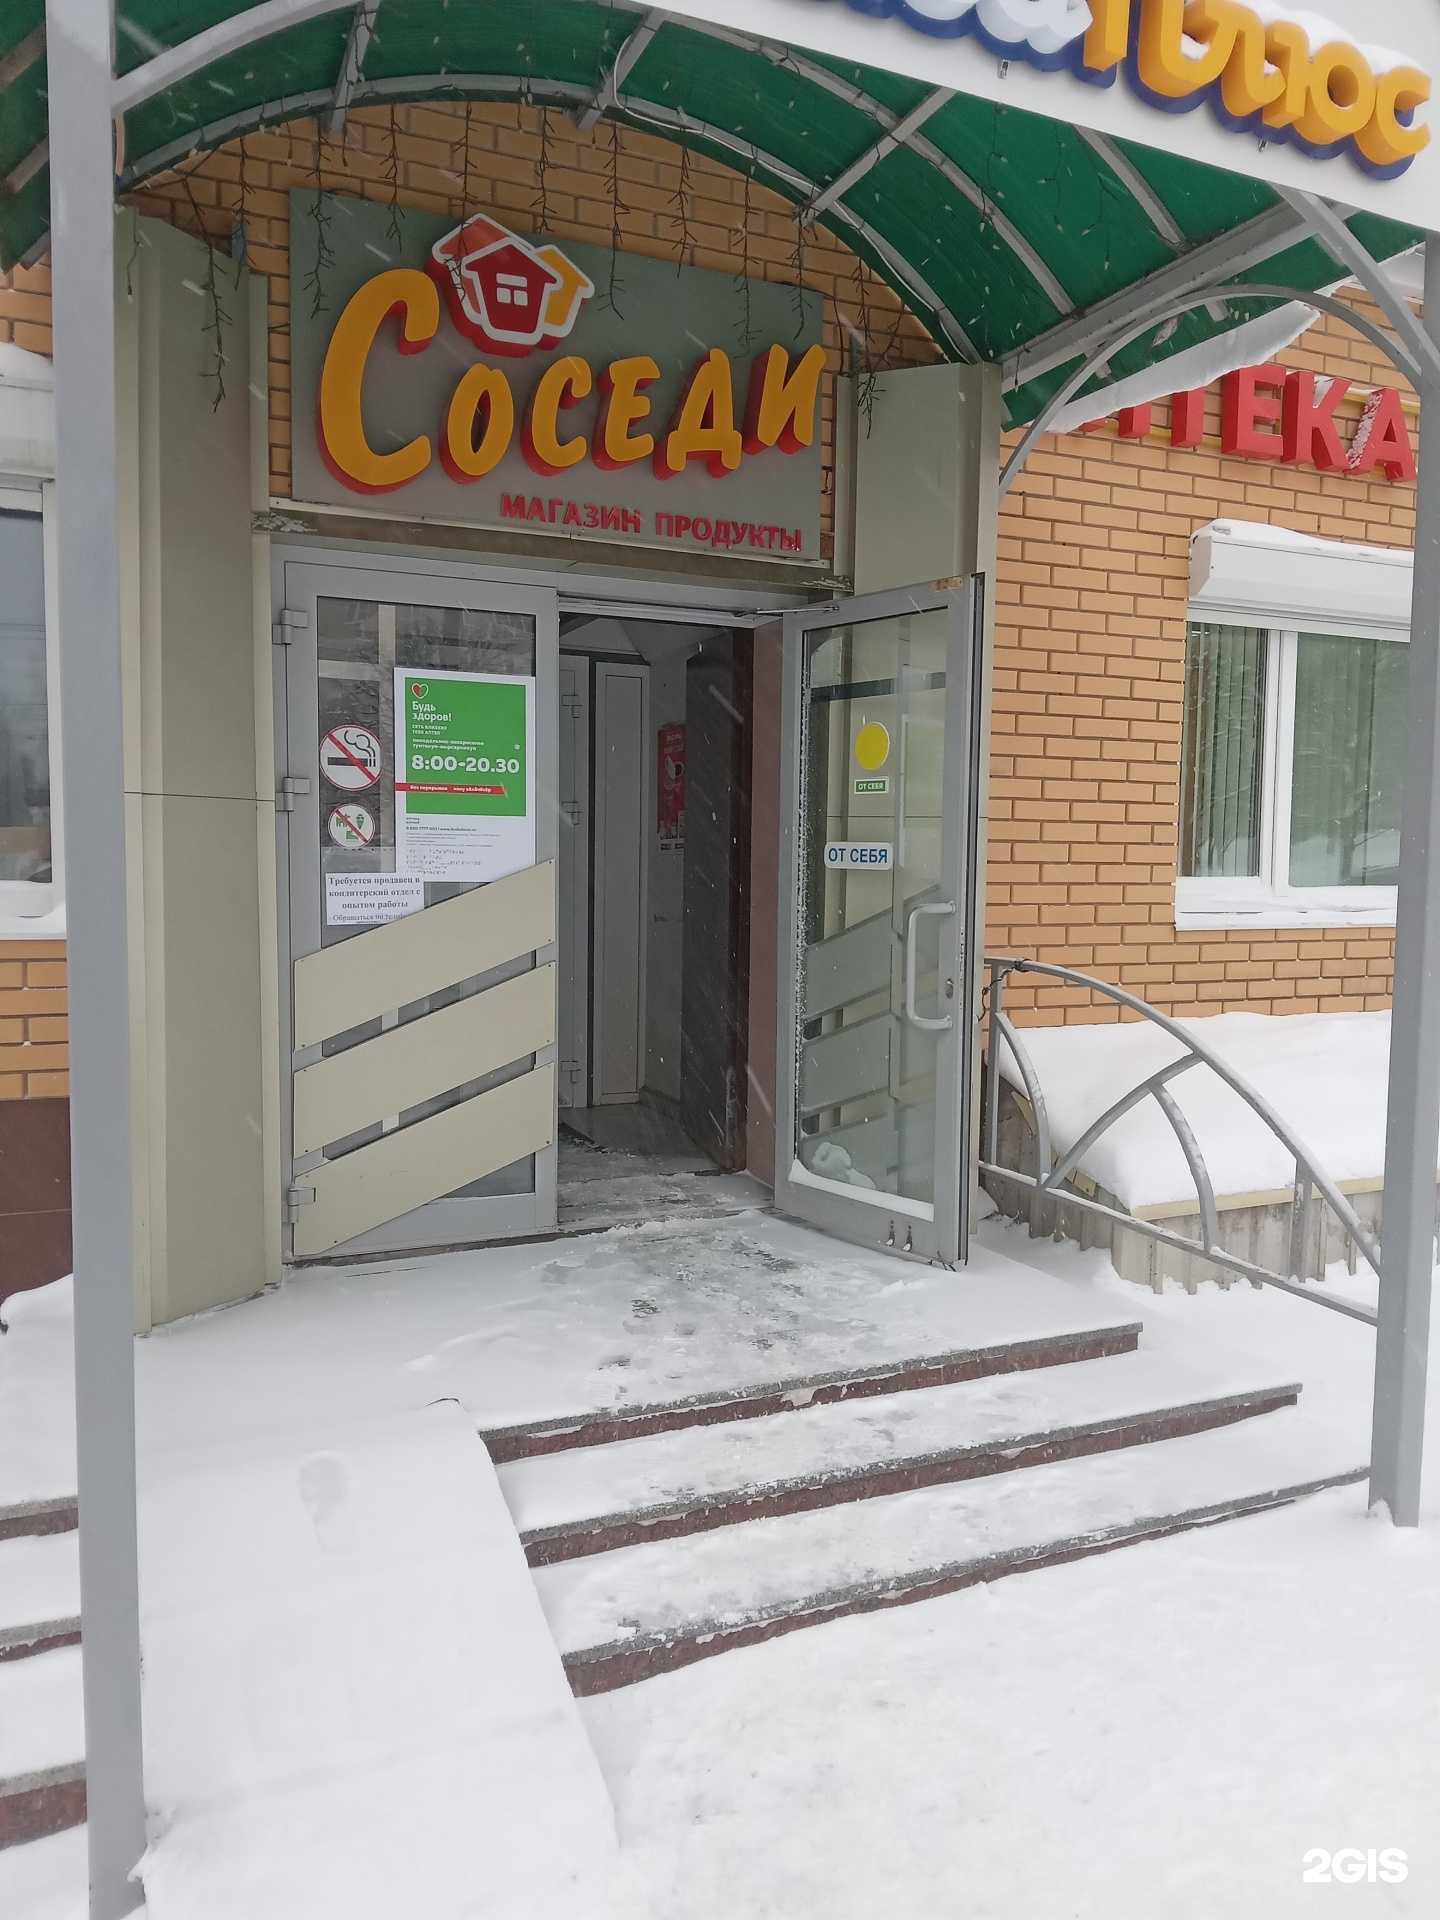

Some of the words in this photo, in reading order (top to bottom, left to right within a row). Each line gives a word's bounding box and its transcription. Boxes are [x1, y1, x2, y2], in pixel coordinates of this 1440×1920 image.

[500, 493, 642, 533] МАГАЗИН
[654, 512, 803, 551] ПРОДУКТЫ
[412, 701, 436, 712] Будь
[412, 712, 452, 722] здоров!
[411, 754, 520, 774] 8:00-20.30
[868, 782, 884, 790] СЕБЯ
[828, 847, 846, 862] ОТ
[850, 848, 888, 863] СЕБЯ
[328, 877, 372, 887] Требуется
[391, 889, 414, 897] отдел
[377, 900, 408, 910] работы
